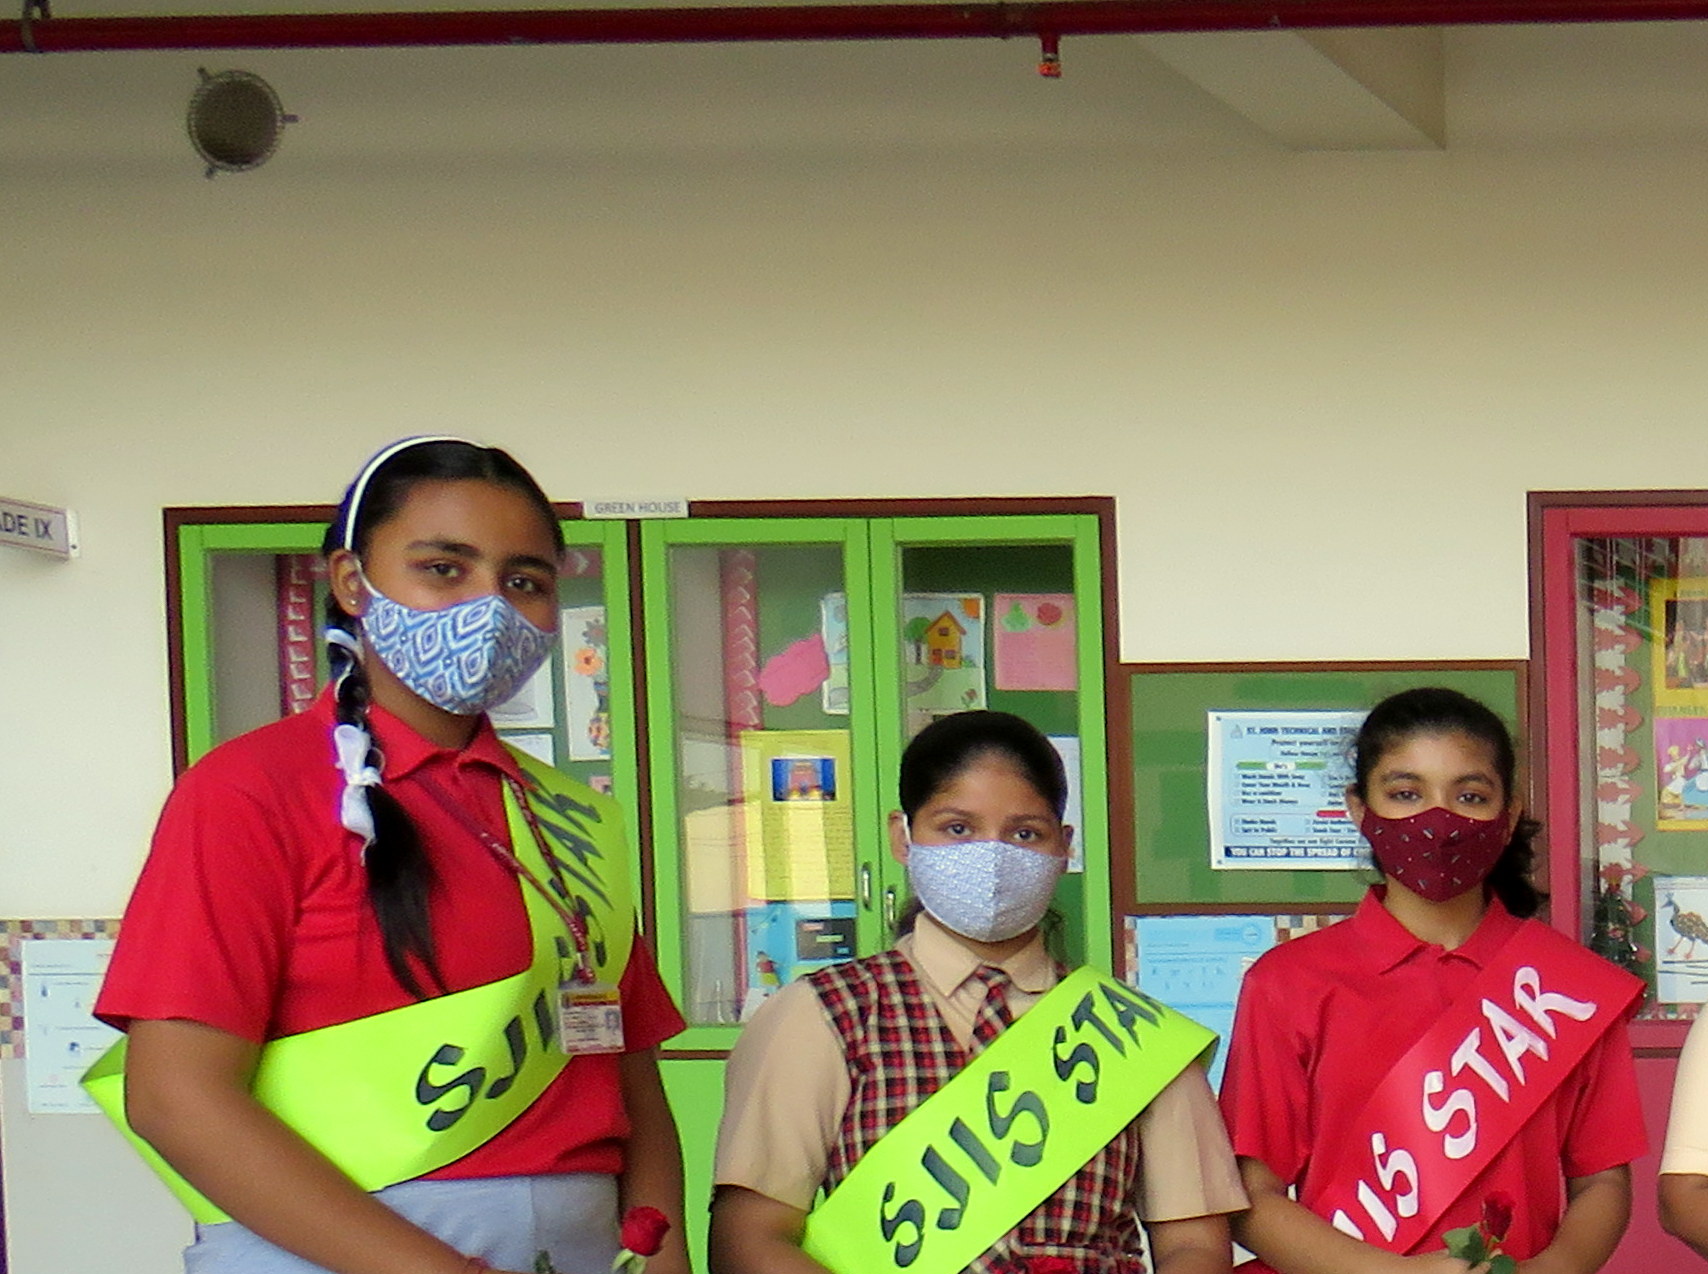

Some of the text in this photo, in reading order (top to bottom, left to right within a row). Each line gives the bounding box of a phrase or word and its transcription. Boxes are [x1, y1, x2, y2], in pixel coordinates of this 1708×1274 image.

[0, 511, 54, 541] DE IX
[594, 501, 681, 514] GREEN HOUSE
[1421, 965, 1598, 1160] STAR
[879, 981, 1169, 1269] SJIS STA
